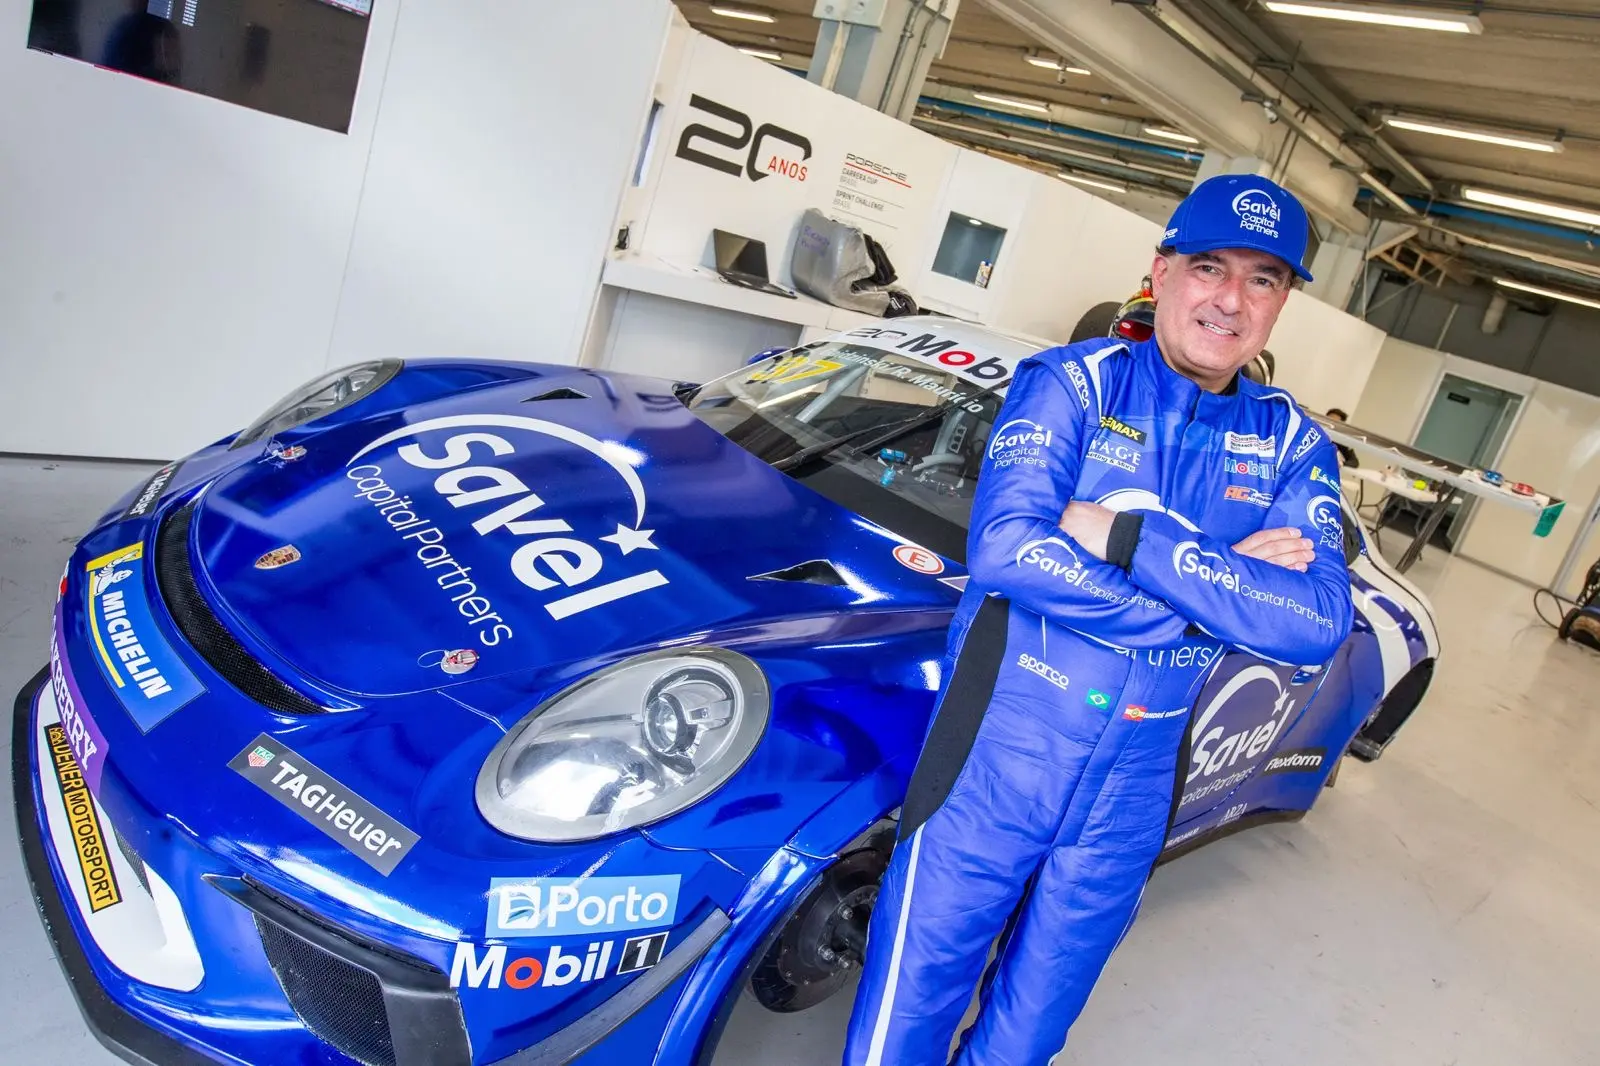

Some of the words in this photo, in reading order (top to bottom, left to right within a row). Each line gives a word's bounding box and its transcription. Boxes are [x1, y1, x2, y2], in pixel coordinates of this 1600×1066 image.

[675, 93, 812, 182] 20
[767, 155, 808, 182] ANOS
[842, 167, 867, 181] CARRERA
[846, 153, 908, 182] PORSCHE
[836, 189, 855, 200] SPRINT
[855, 196, 884, 212] CHALLENGE
[1238, 198, 1281, 222] Savel
[1240, 221, 1279, 239] Partners
[1241, 212, 1275, 227] Capital
[1062, 360, 1090, 411] sparco
[994, 430, 1053, 454] Savel
[996, 446, 1041, 460] Capital
[993, 454, 1047, 470] Partners
[1224, 456, 1270, 480] Mobil
[397, 432, 671, 621] Savel
[346, 464, 430, 532] Capital
[402, 527, 513, 647] Partners
[909, 552, 928, 568] E
[1024, 547, 1090, 588] Savel
[1081, 580, 1121, 604] Capital
[1182, 554, 1241, 593] Savel
[1241, 582, 1284, 608] Capital
[1286, 596, 1334, 629] Partners
[102, 590, 172, 699] MICHELIN
[1017, 652, 1069, 689] sparco
[255, 747, 273, 760] TAG
[1186, 700, 1296, 784] Savel
[53, 743, 85, 795] DENER
[69, 788, 113, 902] MOTORSPORT
[271, 760, 402, 857] TAGHeuer
[547, 885, 668, 927] Porto
[450, 941, 615, 990] Mobil
[635, 938, 652, 968] 1
